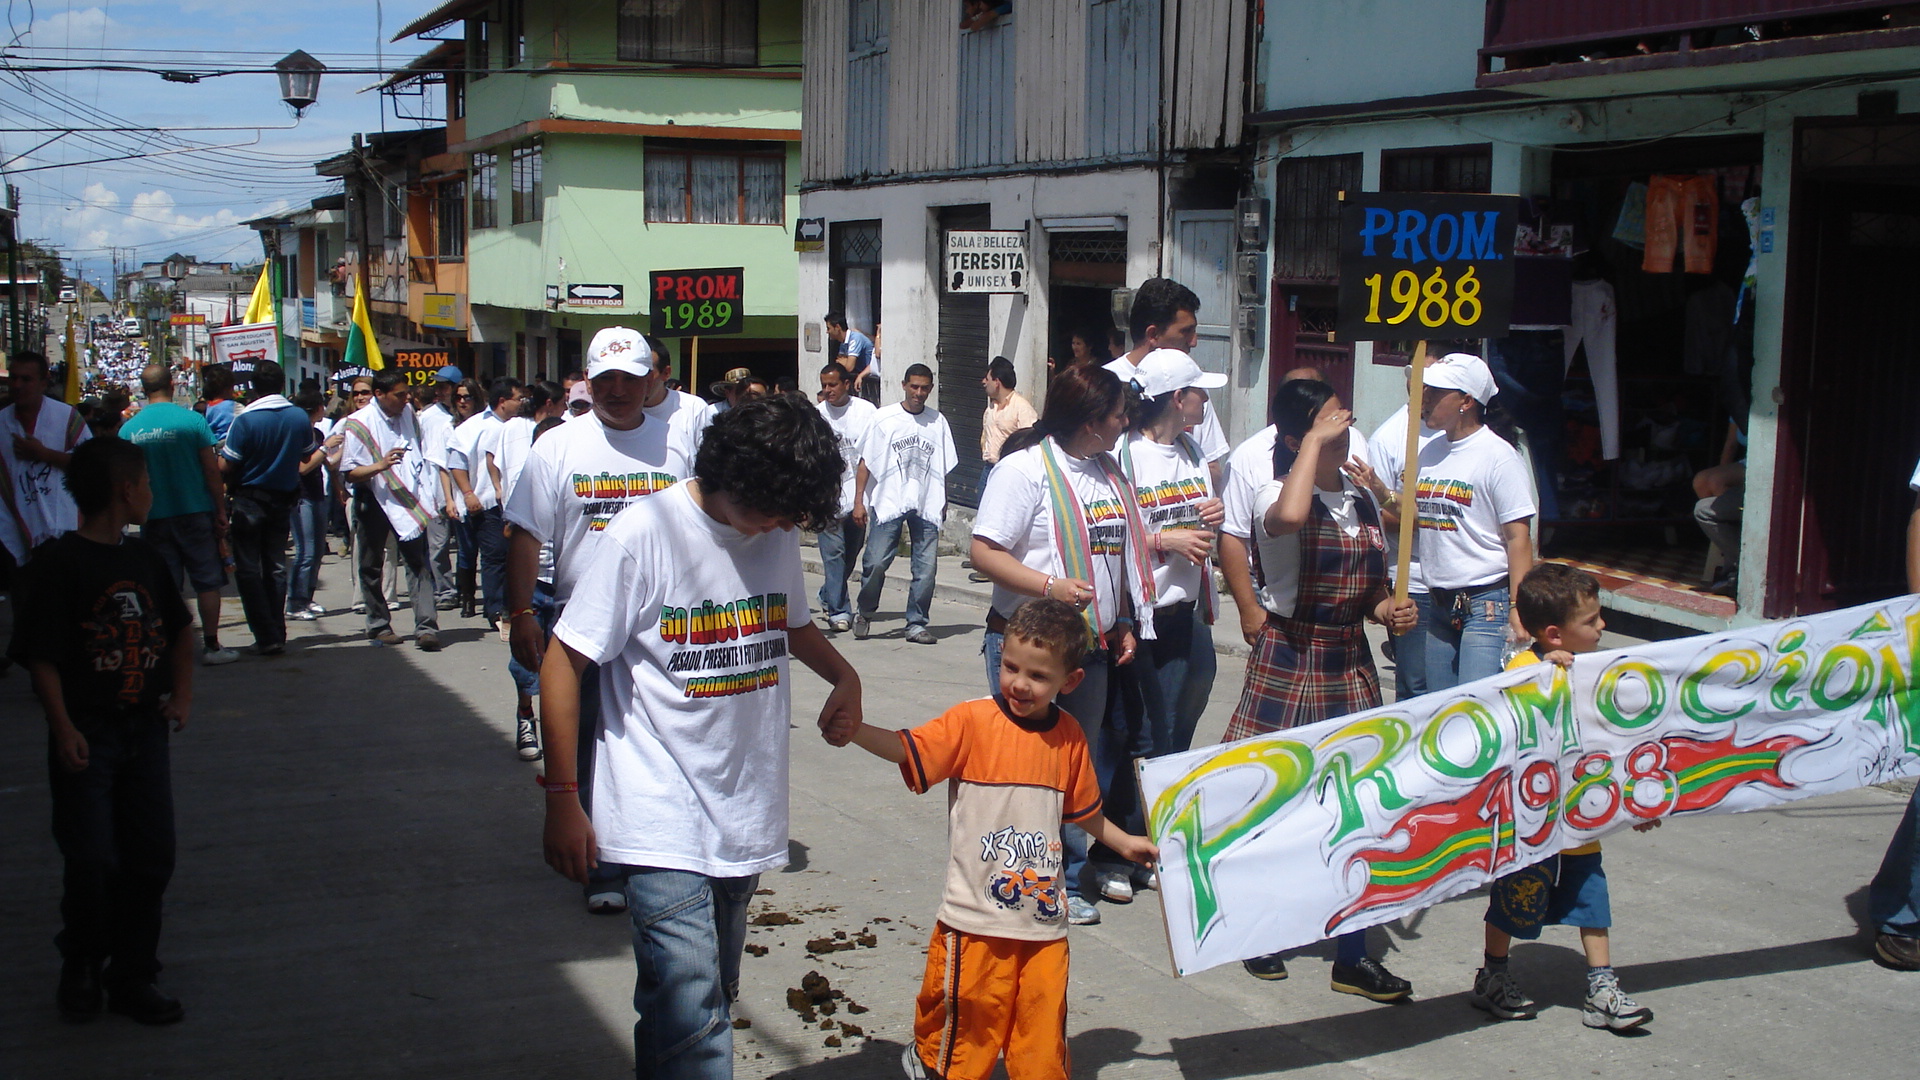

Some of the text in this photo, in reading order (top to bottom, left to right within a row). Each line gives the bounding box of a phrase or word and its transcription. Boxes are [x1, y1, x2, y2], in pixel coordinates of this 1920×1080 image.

[950, 236, 975, 248] SALA
[983, 236, 1025, 249] BELLEZA
[1359, 207, 1504, 264] PROM.
[950, 252, 1025, 270] TERESITA
[655, 275, 740, 302] PROM.
[967, 275, 1007, 287] UNISEX
[1364, 265, 1482, 328] 1988
[661, 300, 732, 330] 1989
[395, 352, 454, 368] PROM.
[404, 370, 438, 387] 199
[573, 473, 592, 498] 50
[593, 471, 627, 499] AÑOS
[627, 472, 651, 498] DEL
[660, 604, 688, 645] 50
[690, 599, 739, 645] AÑOS
[736, 594, 766, 638] DEL
[666, 650, 702, 672] PASADO,
[702, 646, 739, 670] PRESENTE
[739, 645, 744, 666] Y
[1478, 739, 1678, 875] 1988
